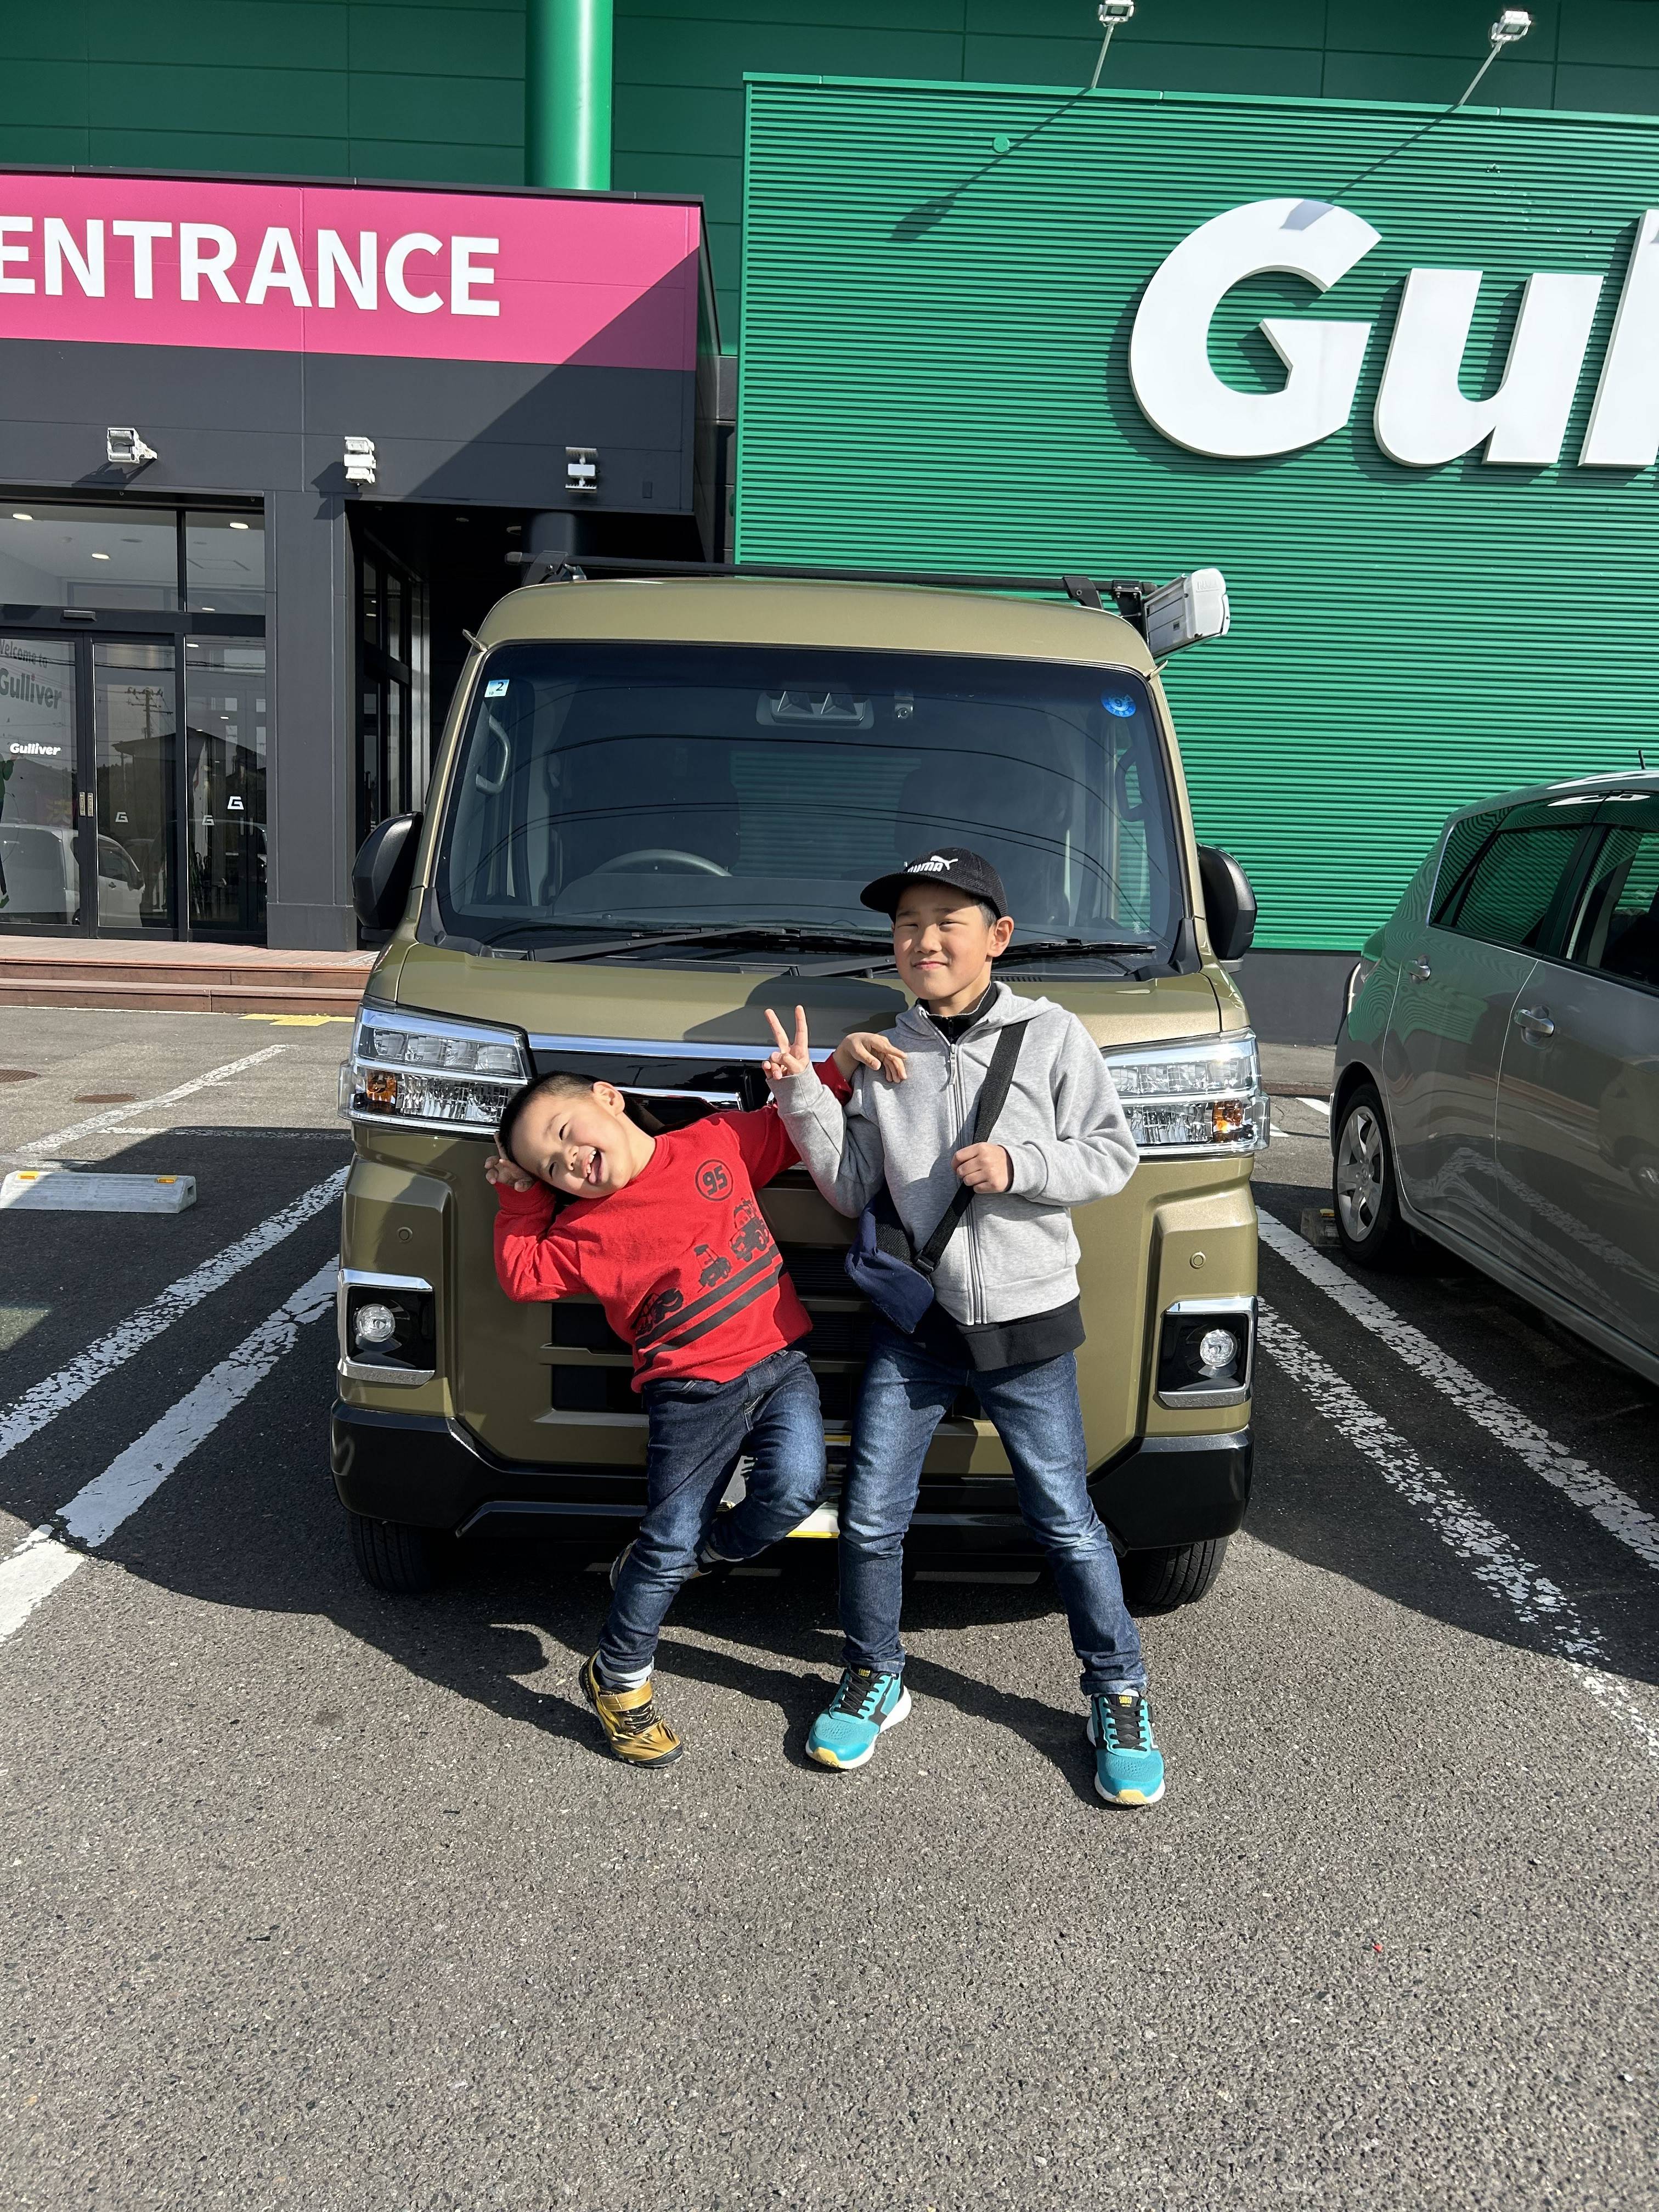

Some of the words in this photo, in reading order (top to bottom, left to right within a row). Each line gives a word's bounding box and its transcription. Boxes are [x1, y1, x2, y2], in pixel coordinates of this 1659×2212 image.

[0, 216, 500, 317] ENTRANCE
[0, 668, 62, 709] Gulliver
[496, 682, 504, 691] 2
[10, 742, 61, 755] Gulliver
[703, 1165, 728, 1195] 95
